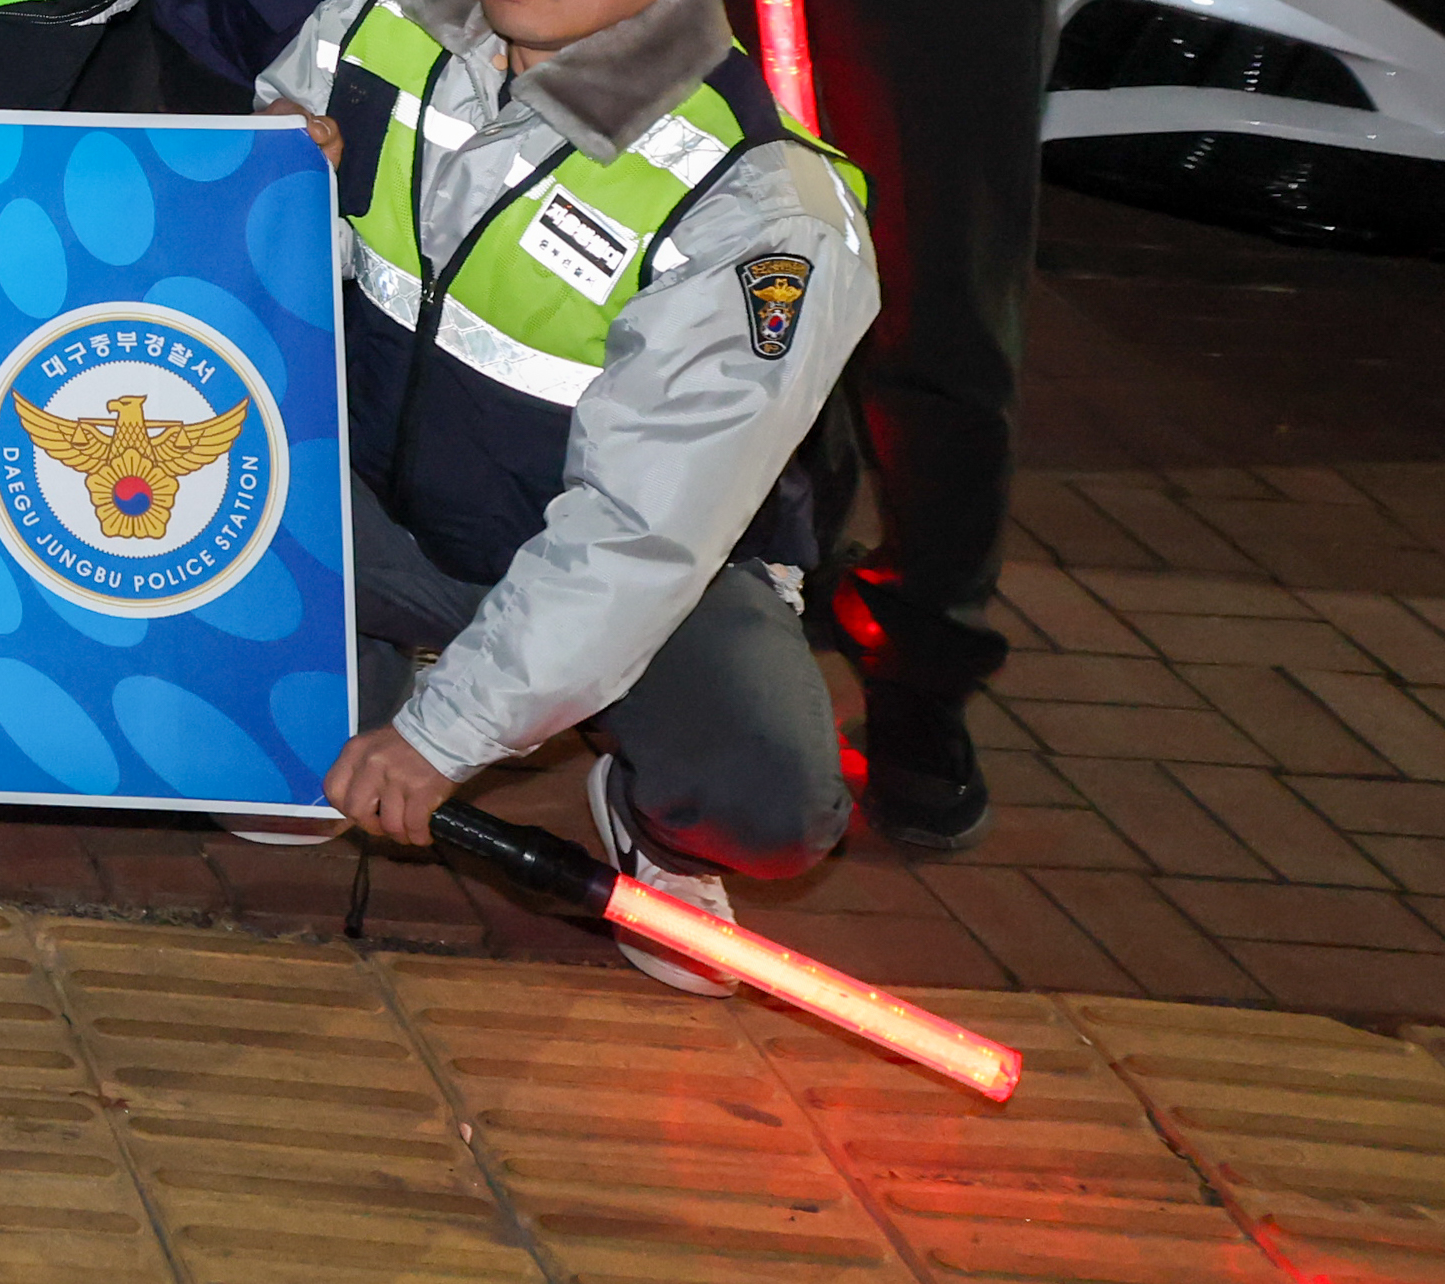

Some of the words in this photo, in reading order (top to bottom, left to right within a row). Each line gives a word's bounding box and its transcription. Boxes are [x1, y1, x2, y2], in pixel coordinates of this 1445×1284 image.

[41, 331, 217, 384] 대구중부경찰서
[3, 447, 41, 528] DAEGU
[36, 532, 122, 589] JUNGBU
[133, 549, 216, 592] POLICE
[214, 455, 259, 551] STATION
